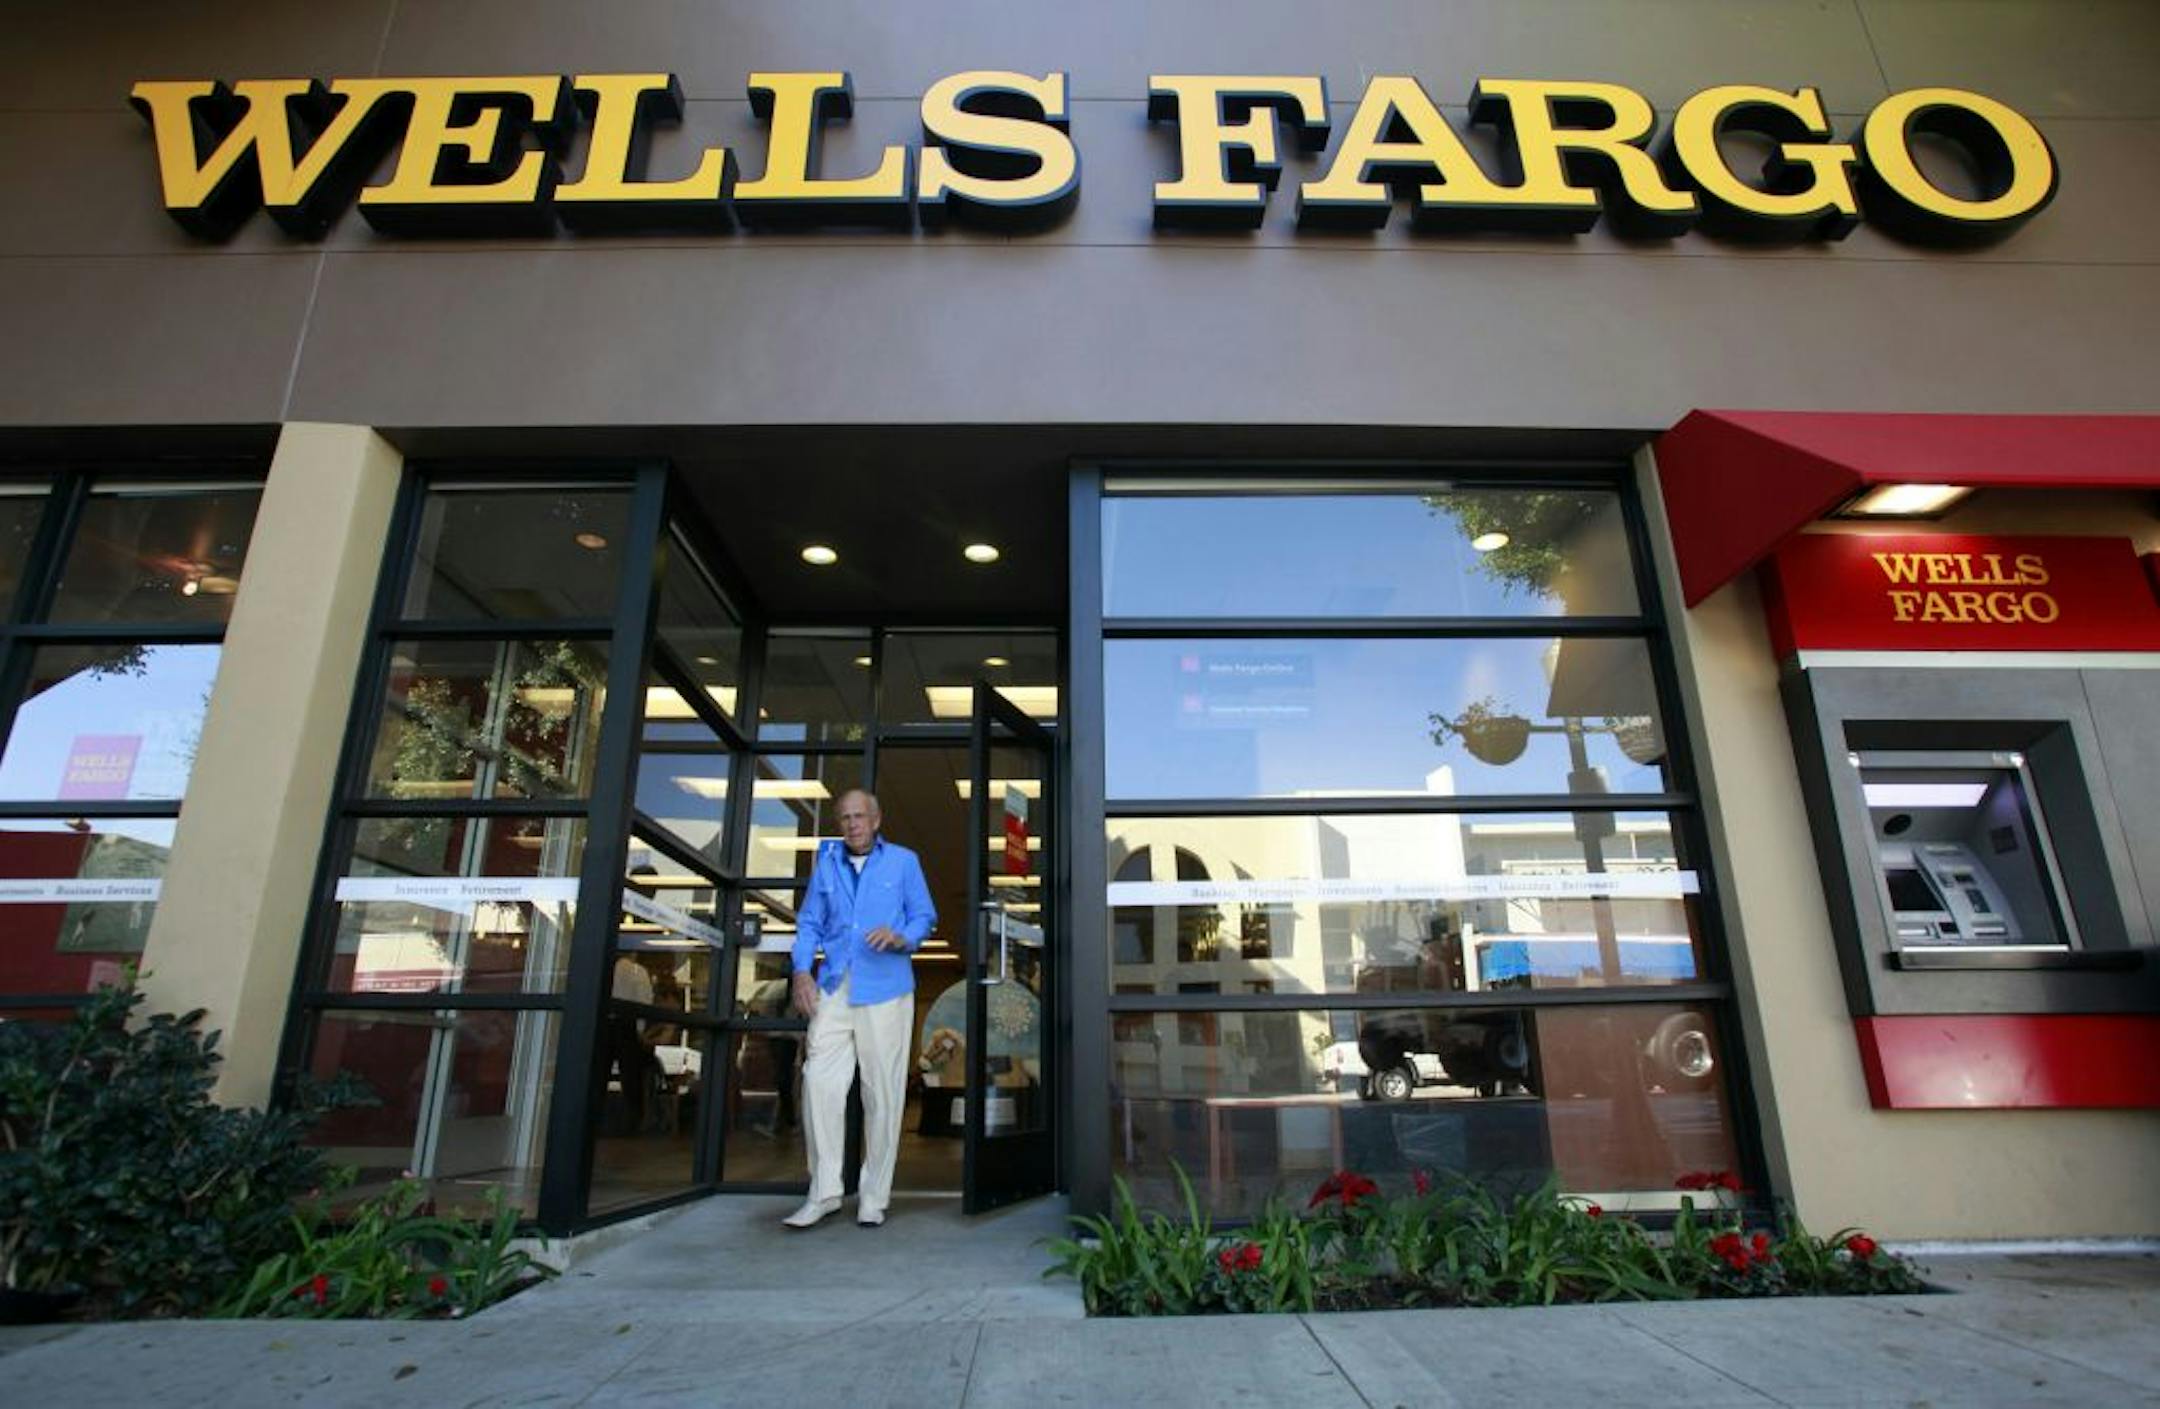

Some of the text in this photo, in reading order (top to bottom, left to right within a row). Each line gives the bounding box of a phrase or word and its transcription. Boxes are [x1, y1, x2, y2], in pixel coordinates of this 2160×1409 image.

[131, 71, 2054, 222] WELLS FARGO
[1872, 553, 2050, 585] WELLS
[1887, 590, 2060, 623] FARGO
[106, 885, 152, 895] Services
